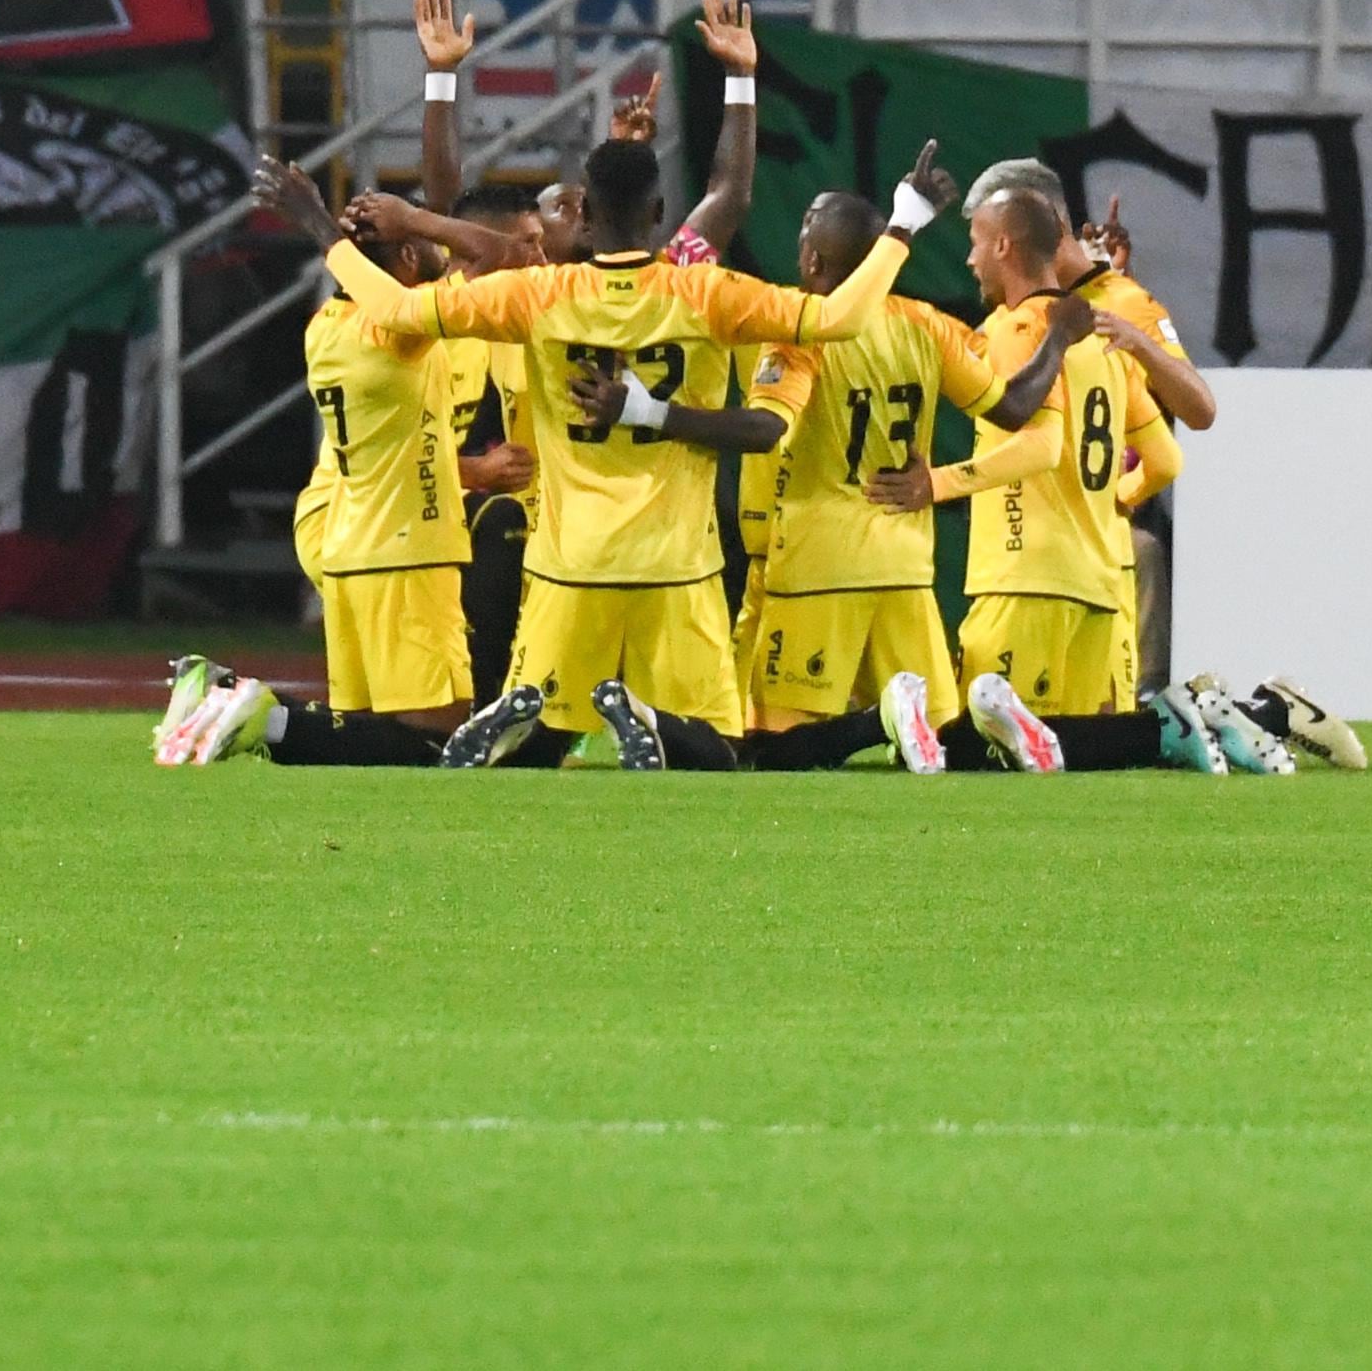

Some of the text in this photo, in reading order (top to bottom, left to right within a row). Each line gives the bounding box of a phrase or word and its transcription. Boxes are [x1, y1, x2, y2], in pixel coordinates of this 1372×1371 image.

[606, 280, 634, 291] FILA
[846, 382, 923, 485] 13
[1079, 386, 1114, 492] 8
[416, 430, 440, 522] BetPlay
[1003, 478, 1023, 552] BetPla
[765, 629, 783, 676] FILA
